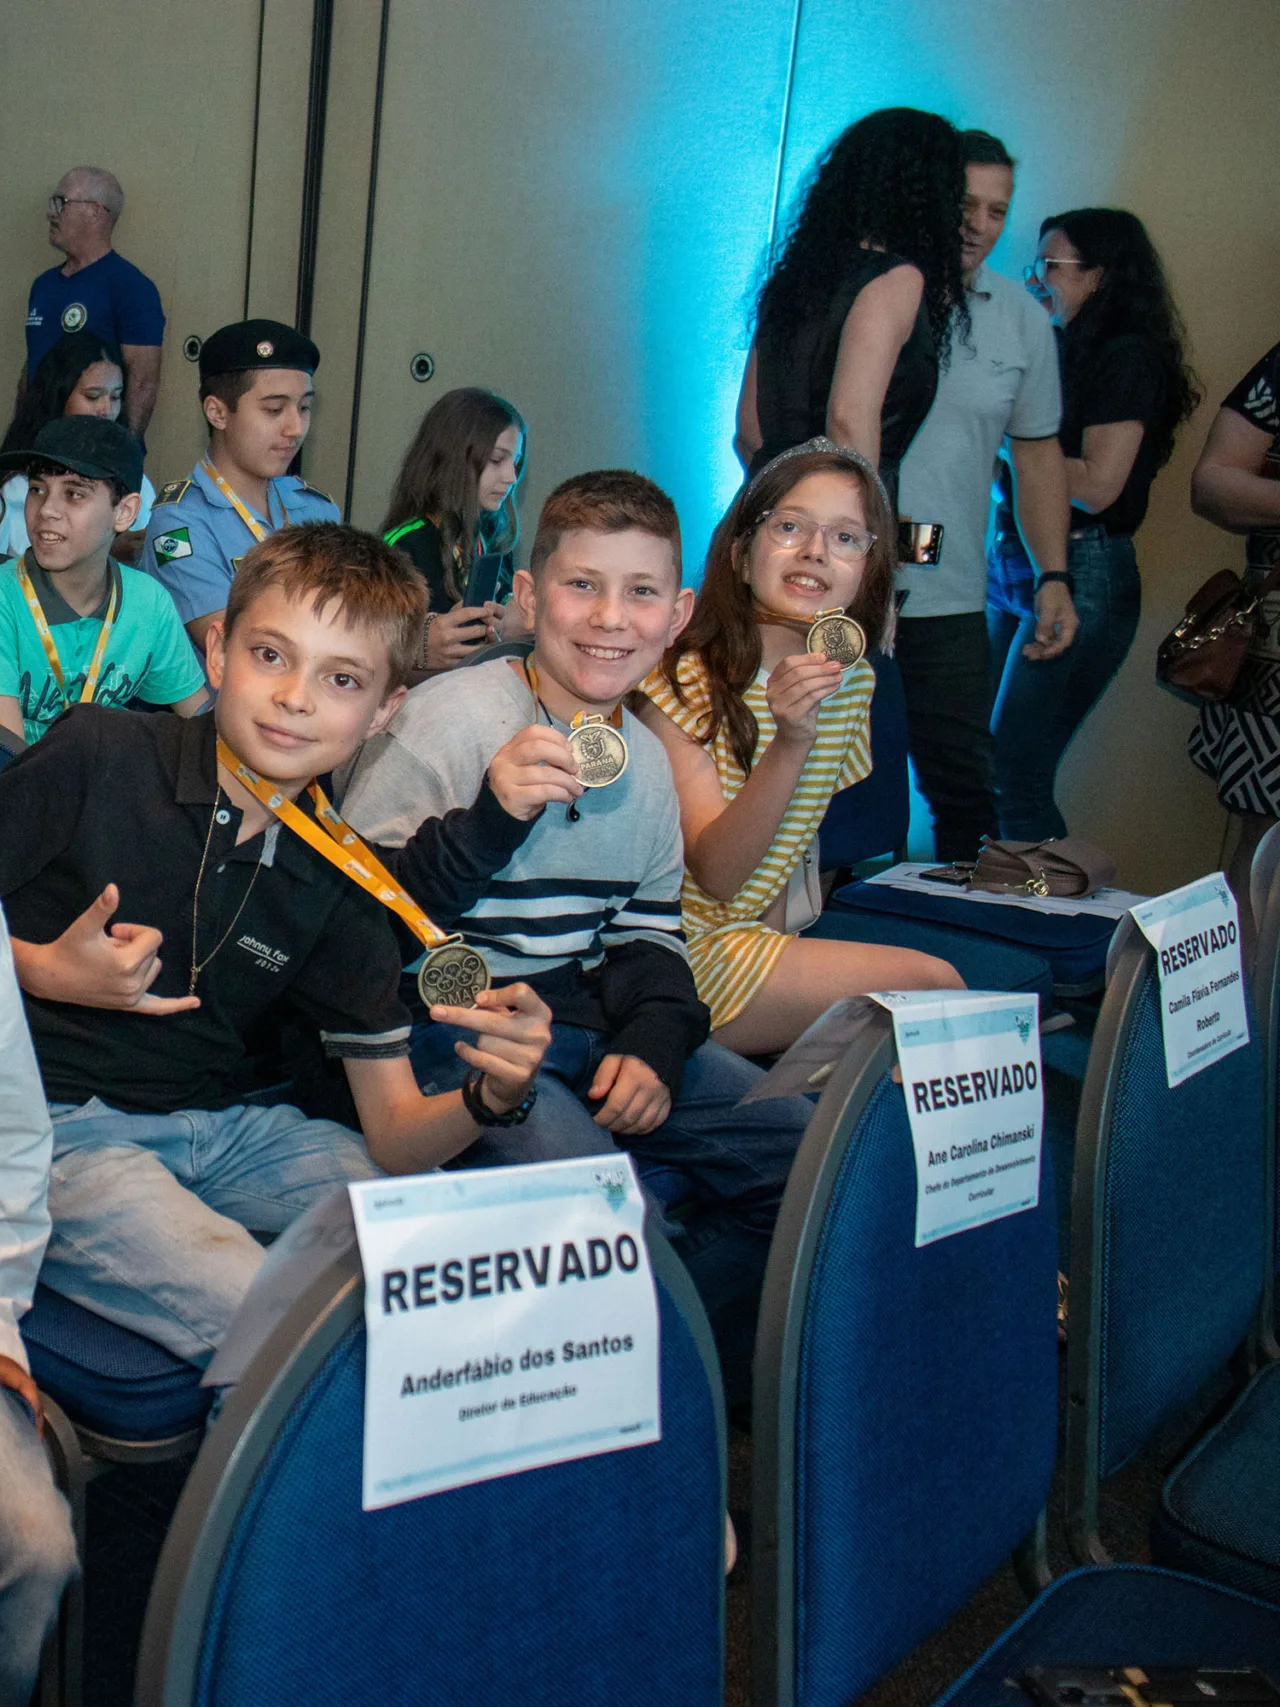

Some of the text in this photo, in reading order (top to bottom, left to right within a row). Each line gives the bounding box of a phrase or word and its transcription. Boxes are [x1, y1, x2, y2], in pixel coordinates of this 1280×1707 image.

[272, 949, 290, 963] fox
[1160, 920, 1237, 977] RESERVADO
[1168, 994, 1192, 1015] Camila
[1209, 969, 1240, 994] Fernandes
[1196, 1010, 1221, 1032] Roberto
[911, 1060, 1038, 1114] RESERVADO
[927, 1122, 1036, 1168] Ane Carolina Chimanski
[381, 1233, 640, 1316] RESERVADO
[400, 1333, 635, 1400] Anderfábio dos Santos
